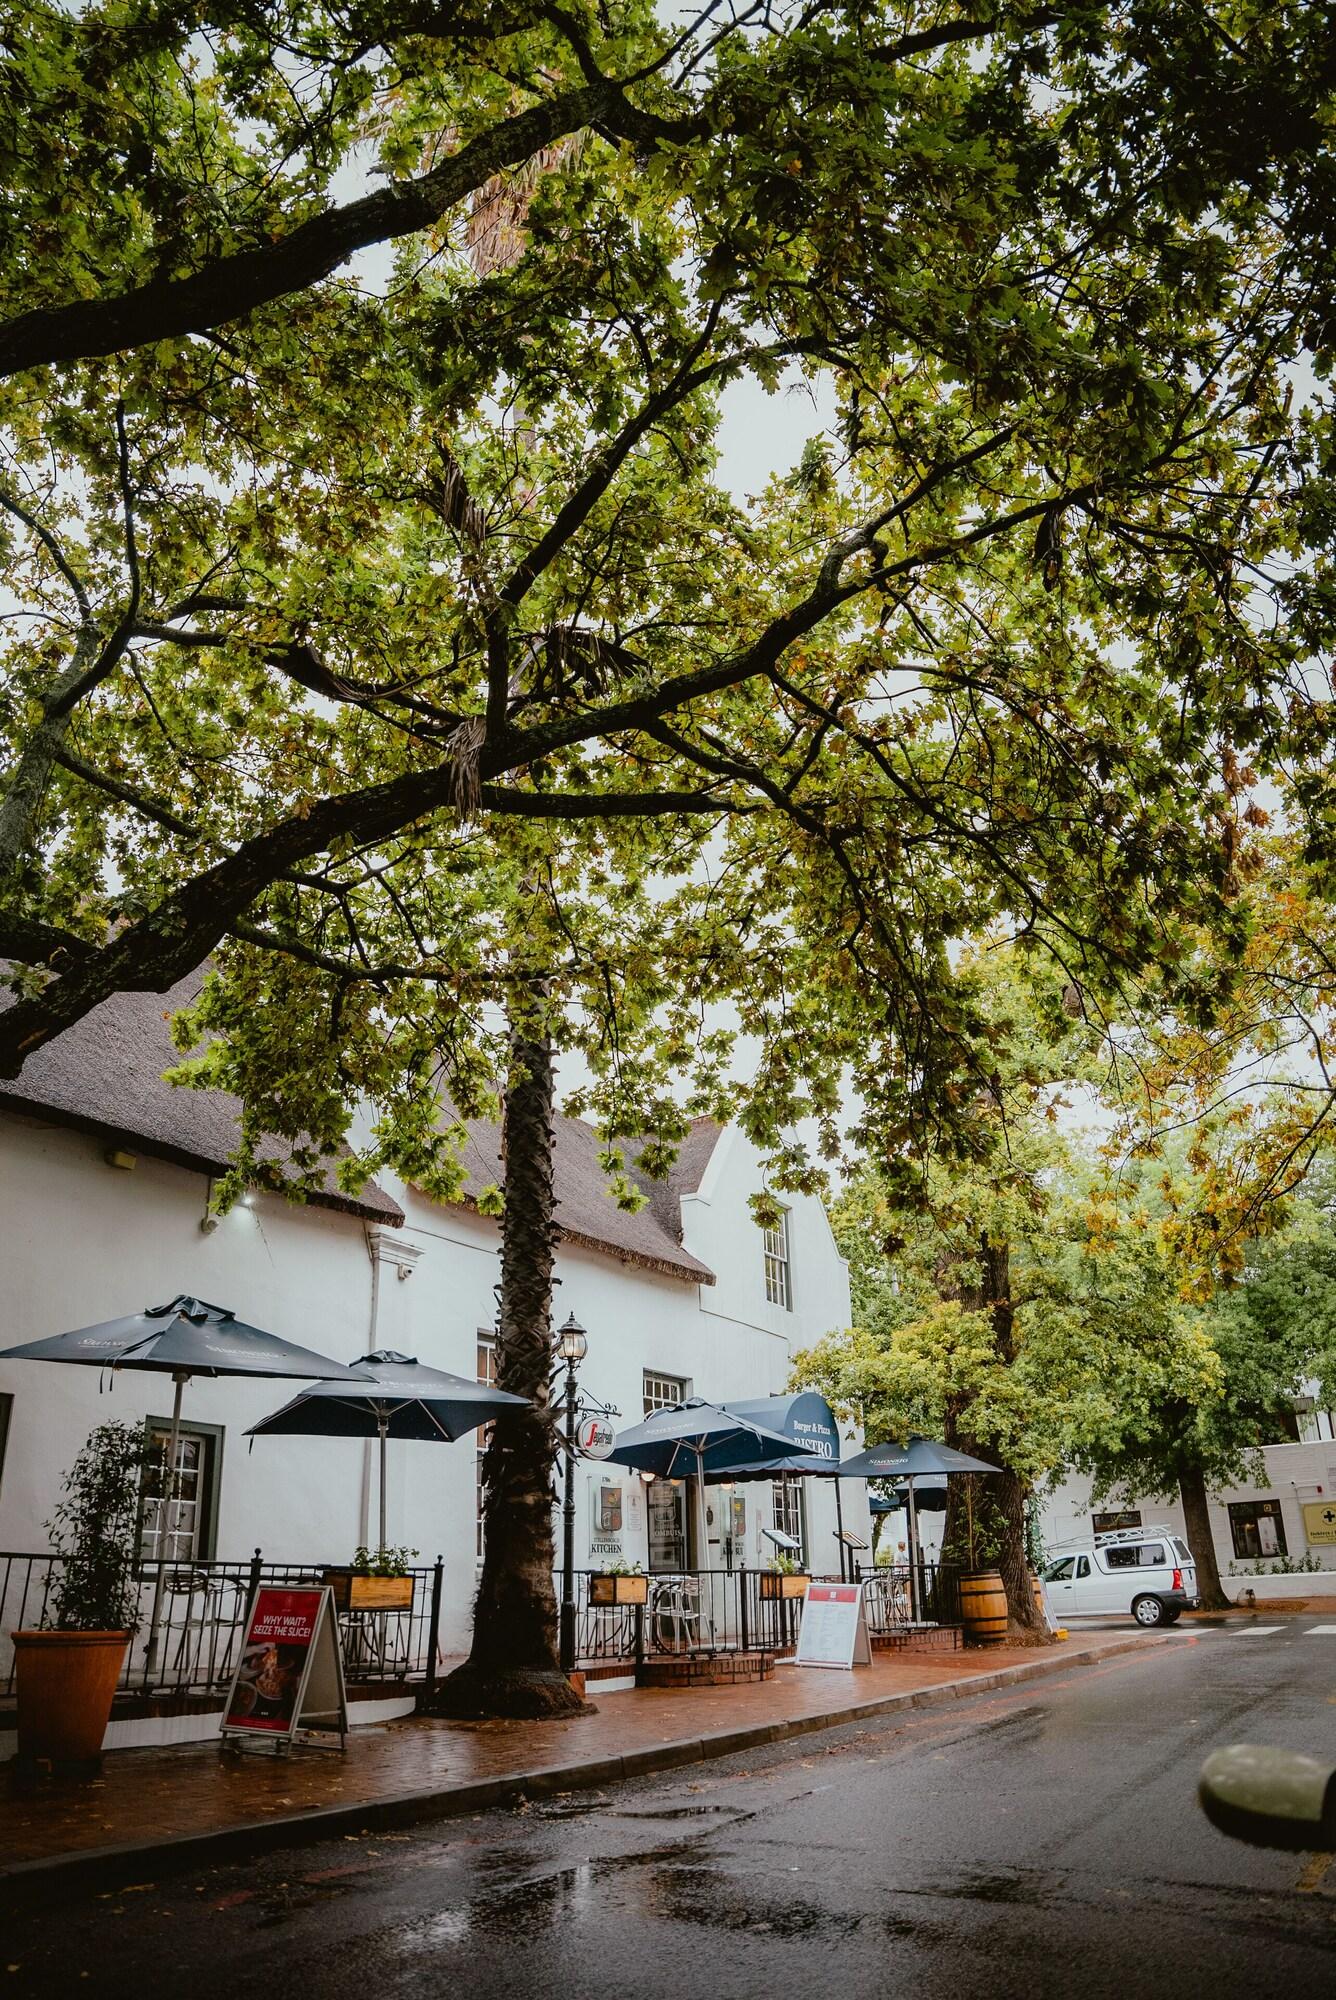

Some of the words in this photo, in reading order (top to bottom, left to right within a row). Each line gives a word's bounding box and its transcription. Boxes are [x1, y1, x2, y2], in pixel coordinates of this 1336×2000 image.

[793, 1419, 812, 1434] Burger
[811, 1422, 818, 1433] &
[817, 1423, 831, 1436] Pizza
[591, 1543, 622, 1554] KITCHEN
[263, 1615, 283, 1625] WHY
[283, 1616, 307, 1627] WAIT?
[253, 1624, 273, 1635] SEIZE
[273, 1625, 288, 1637] THE
[287, 1627, 311, 1638] SLICE!
